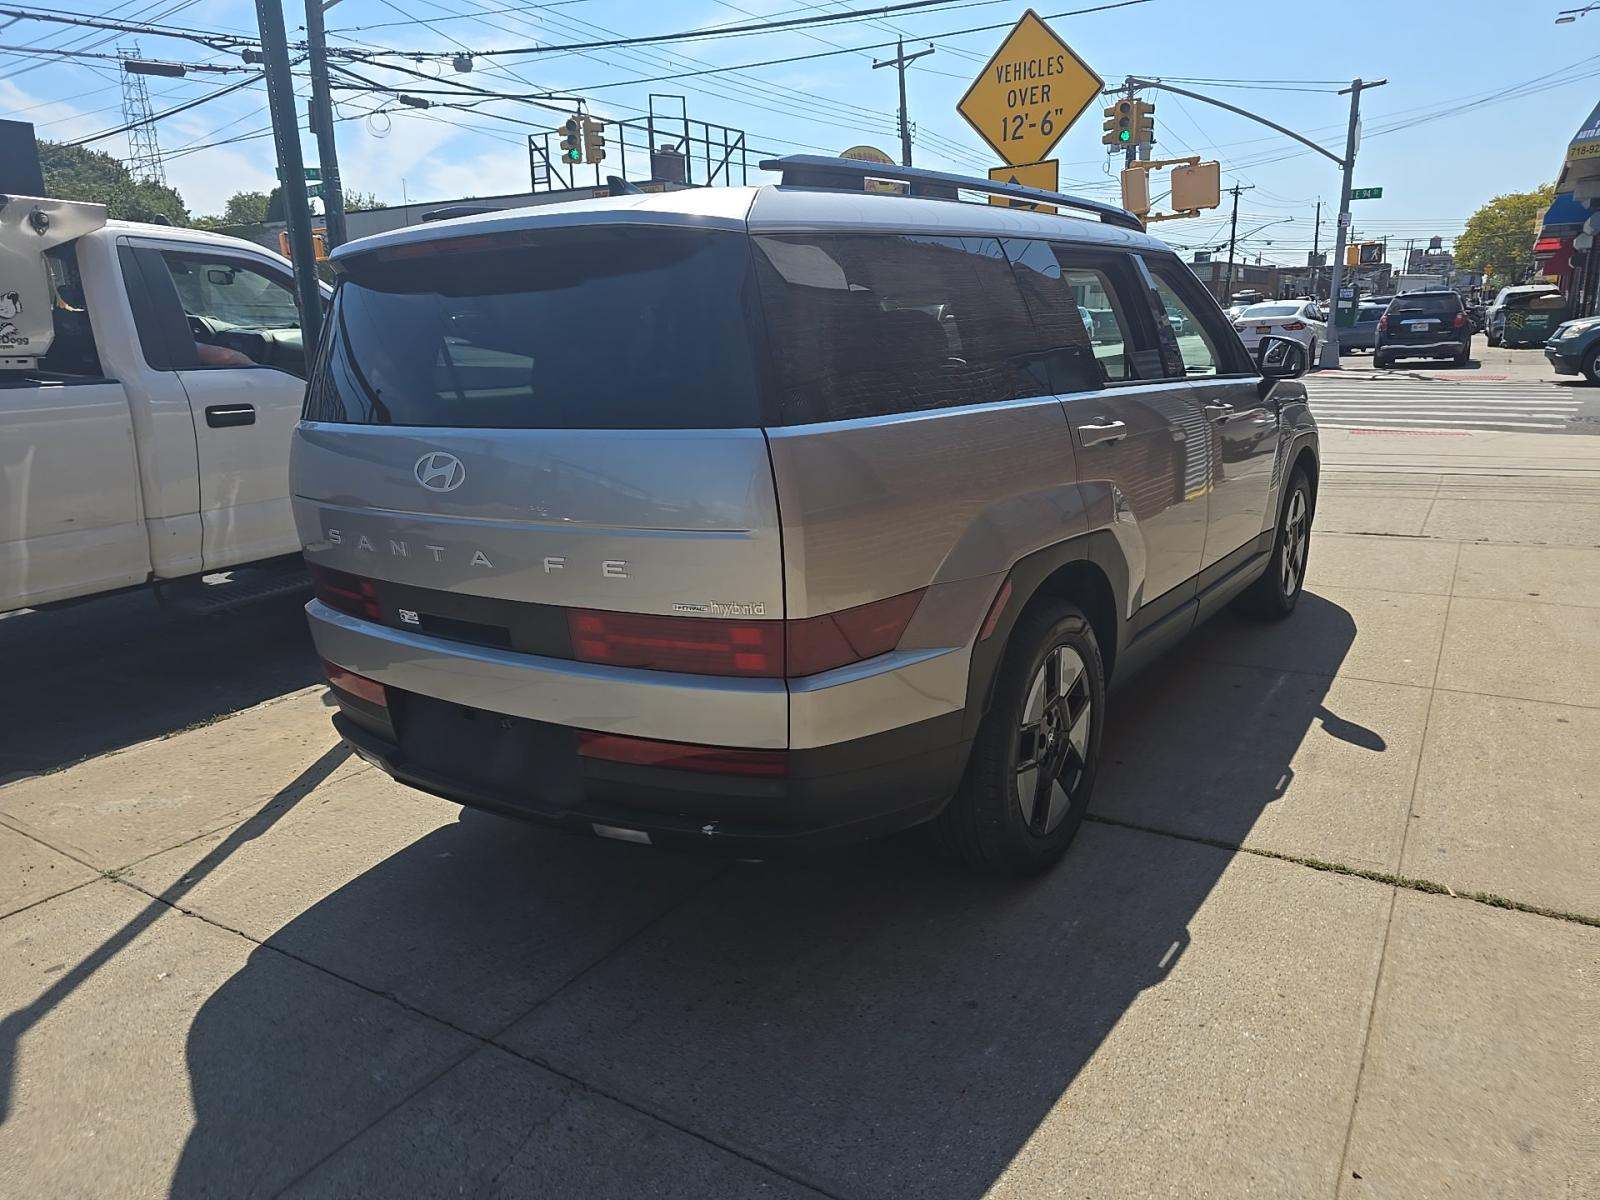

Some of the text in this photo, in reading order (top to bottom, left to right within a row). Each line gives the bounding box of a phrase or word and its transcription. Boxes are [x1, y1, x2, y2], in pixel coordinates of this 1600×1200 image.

[996, 55, 1065, 84] VEHICLES
[1007, 84, 1051, 108] OVER
[1002, 108, 1064, 142] 12'-6"
[327, 528, 631, 580] SANTA FE
[709, 599, 765, 617] hybrid
